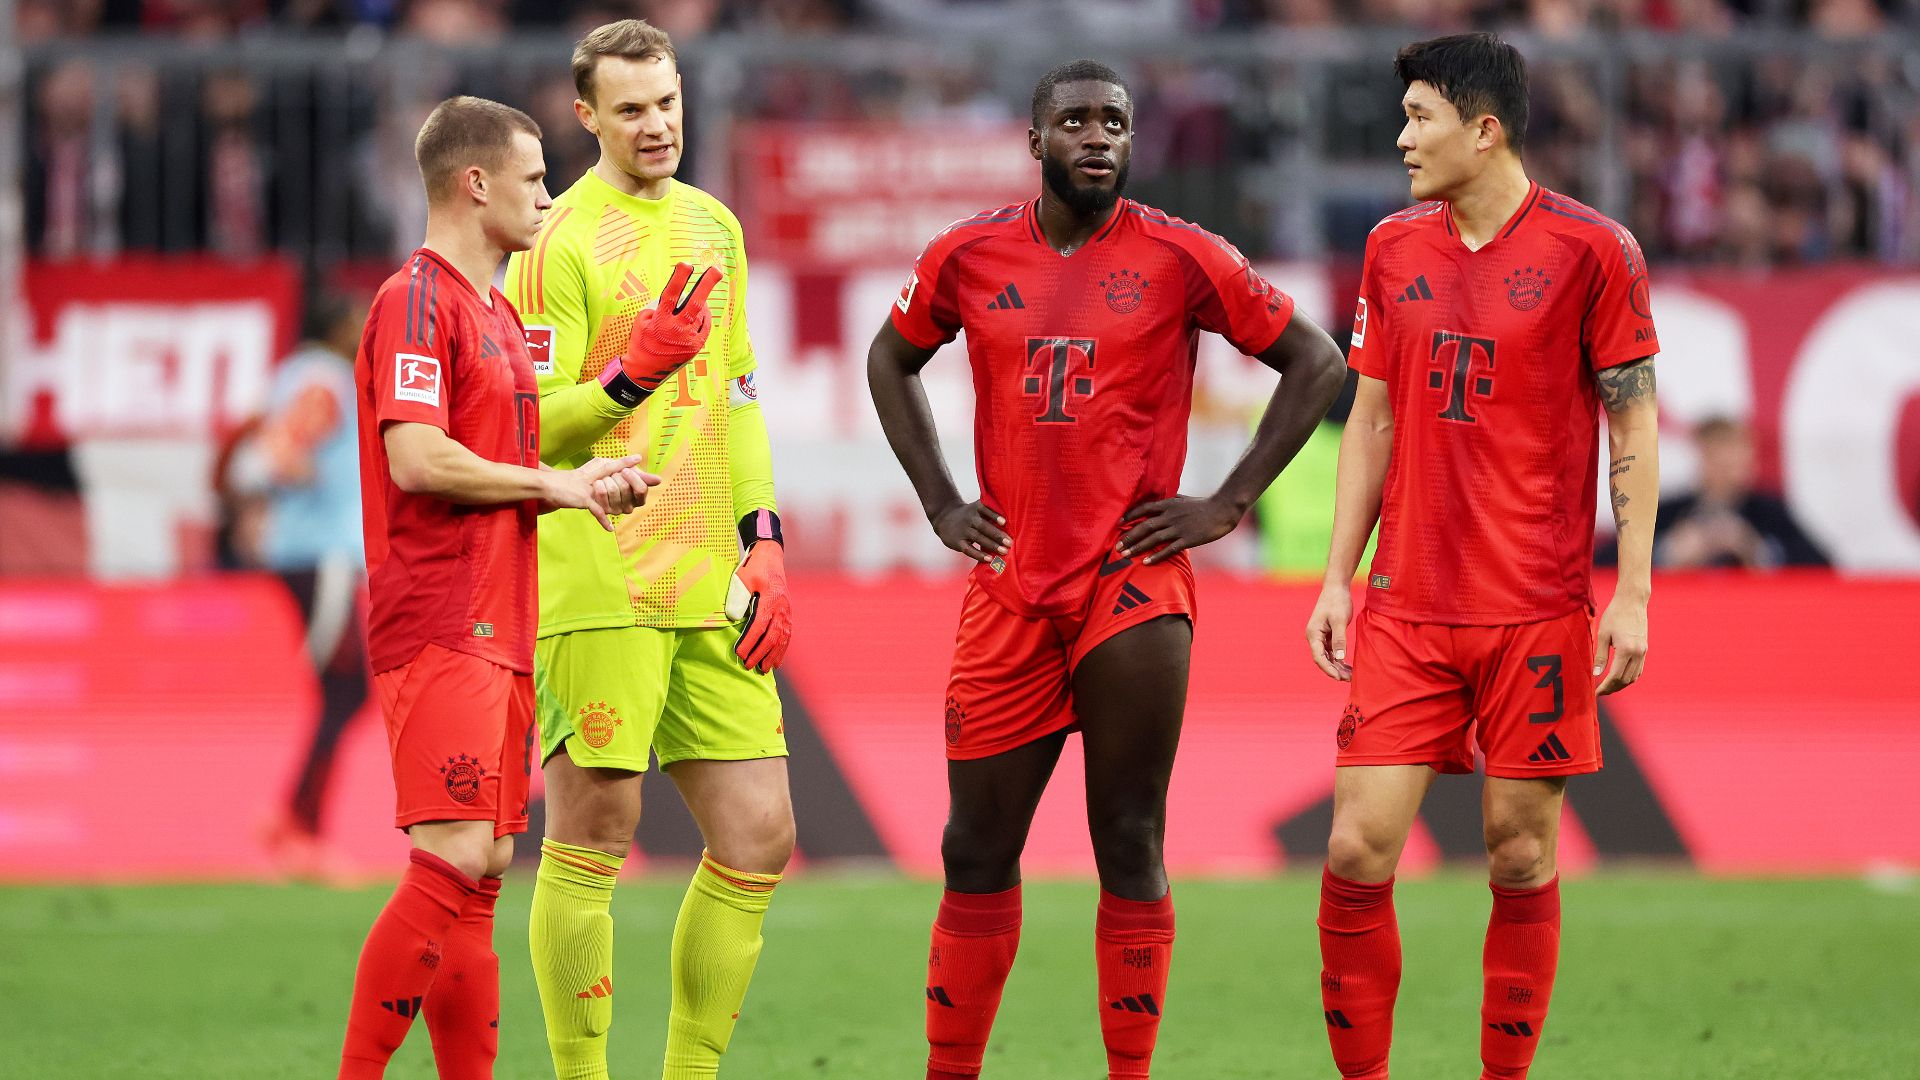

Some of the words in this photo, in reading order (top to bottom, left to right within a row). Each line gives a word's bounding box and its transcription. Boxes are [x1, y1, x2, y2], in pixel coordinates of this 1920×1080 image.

[1022, 336, 1098, 425] T
[1427, 329, 1496, 424] T
[1527, 653, 1564, 725] 3
